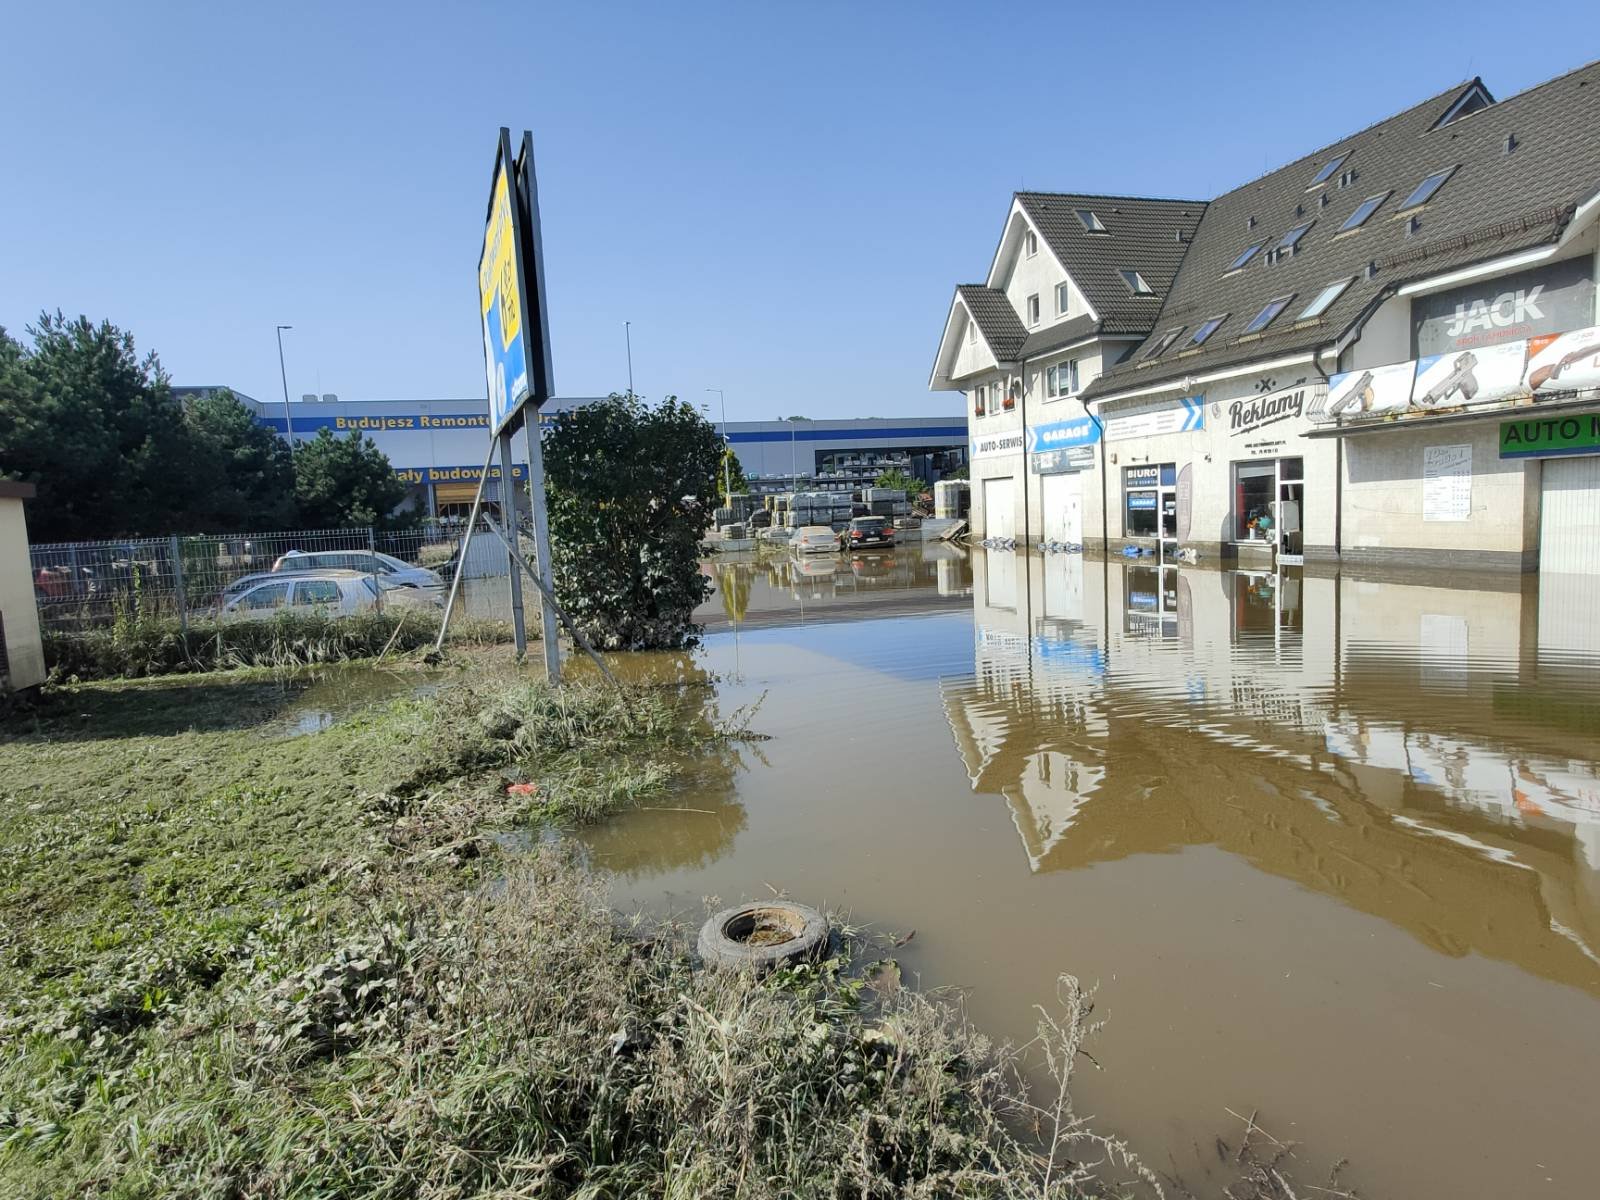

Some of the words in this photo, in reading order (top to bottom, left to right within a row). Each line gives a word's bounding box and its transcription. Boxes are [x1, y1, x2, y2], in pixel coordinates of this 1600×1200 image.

[1444, 285, 1545, 337] JACK
[1228, 390, 1304, 429] Reklamy
[336, 416, 414, 431] Budujesz
[1504, 419, 1580, 445] AUTO
[1043, 427, 1089, 442] GARAGE
[980, 436, 1022, 453] AUTO-SERWIS
[1127, 468, 1157, 479] BIURO
